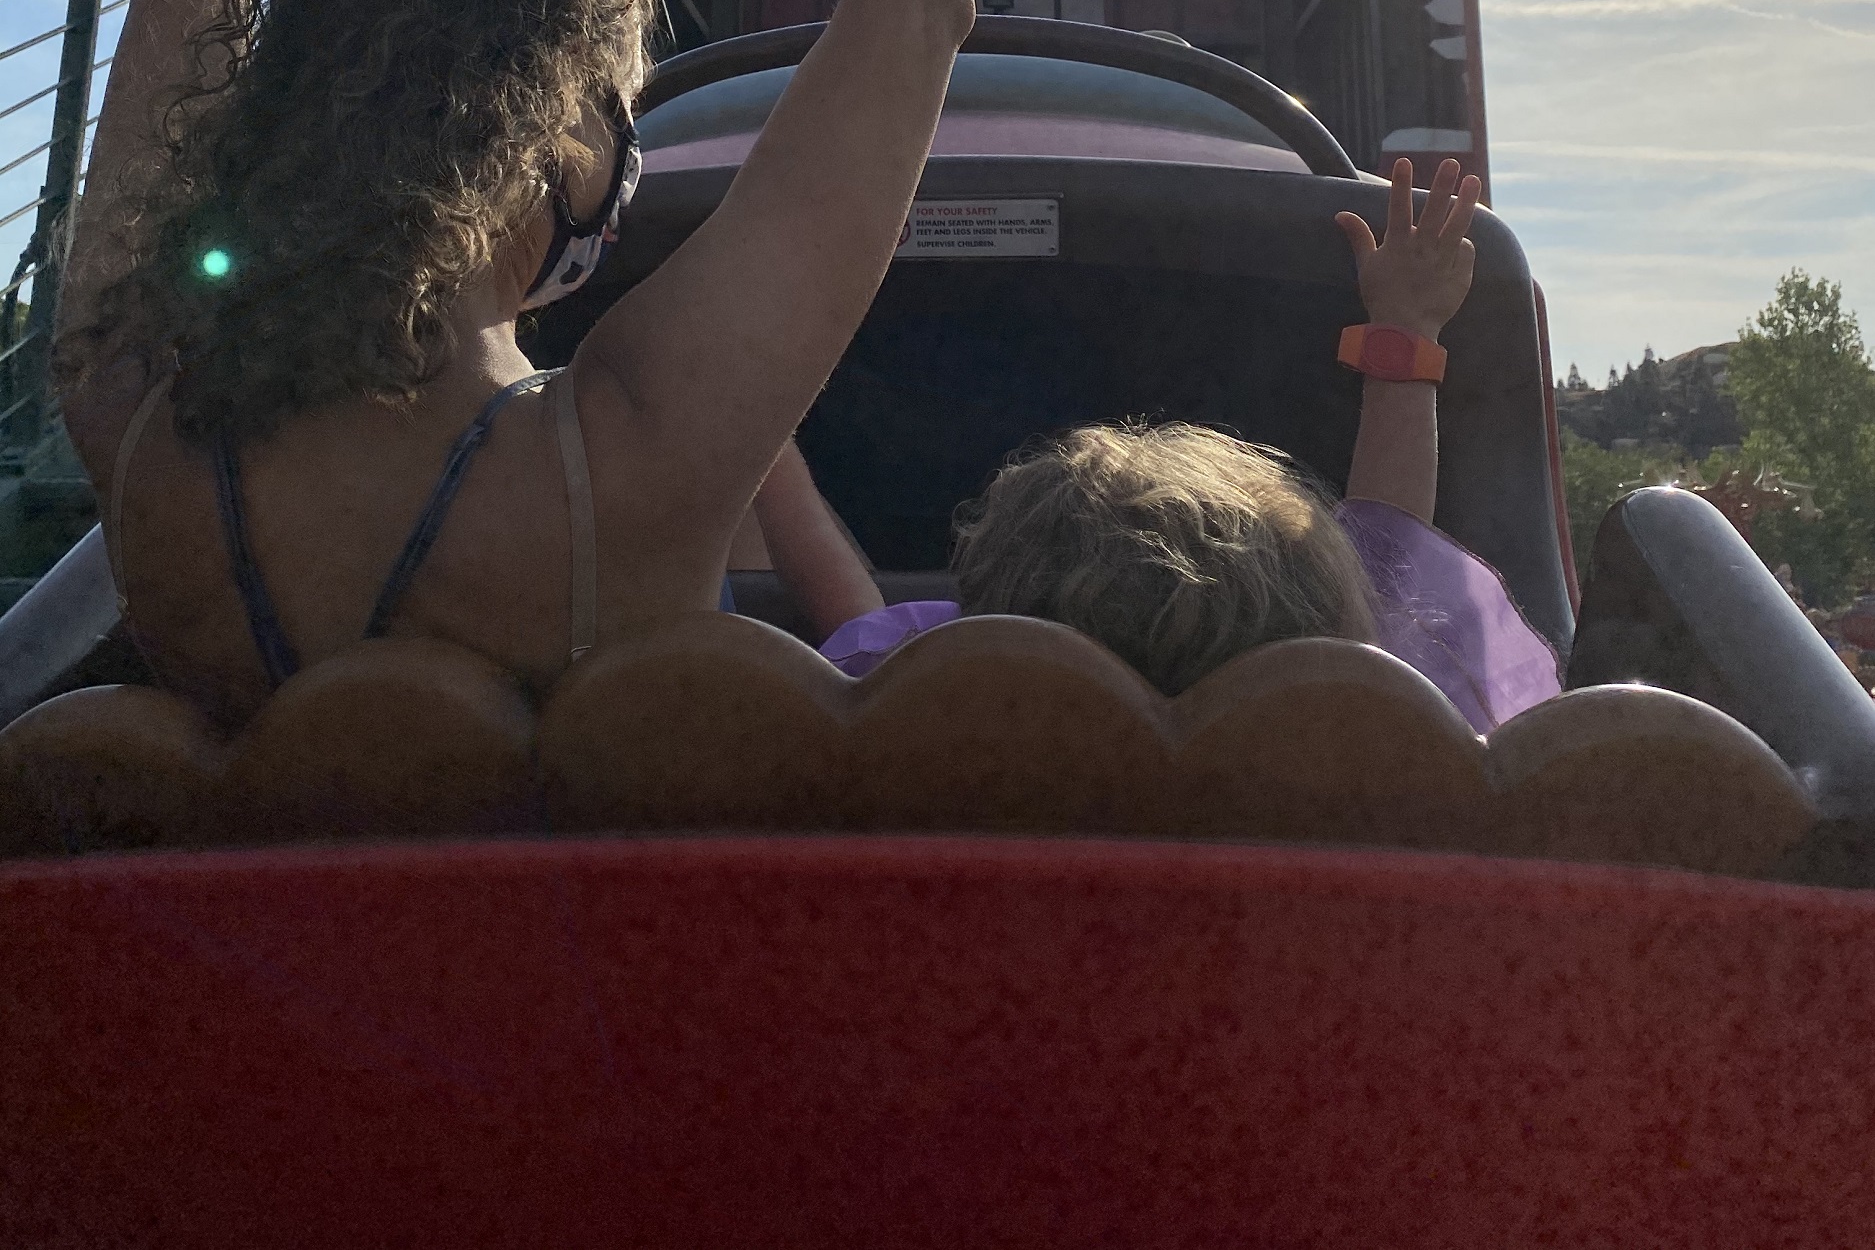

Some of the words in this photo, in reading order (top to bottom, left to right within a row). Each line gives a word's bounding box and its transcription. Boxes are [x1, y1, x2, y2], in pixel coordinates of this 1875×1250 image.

[917, 208, 934, 216] FOR
[937, 208, 962, 216] YOUR
[965, 207, 997, 215] SAFETY
[916, 219, 945, 227] REMAIN
[917, 240, 955, 248] SUPERVISE
